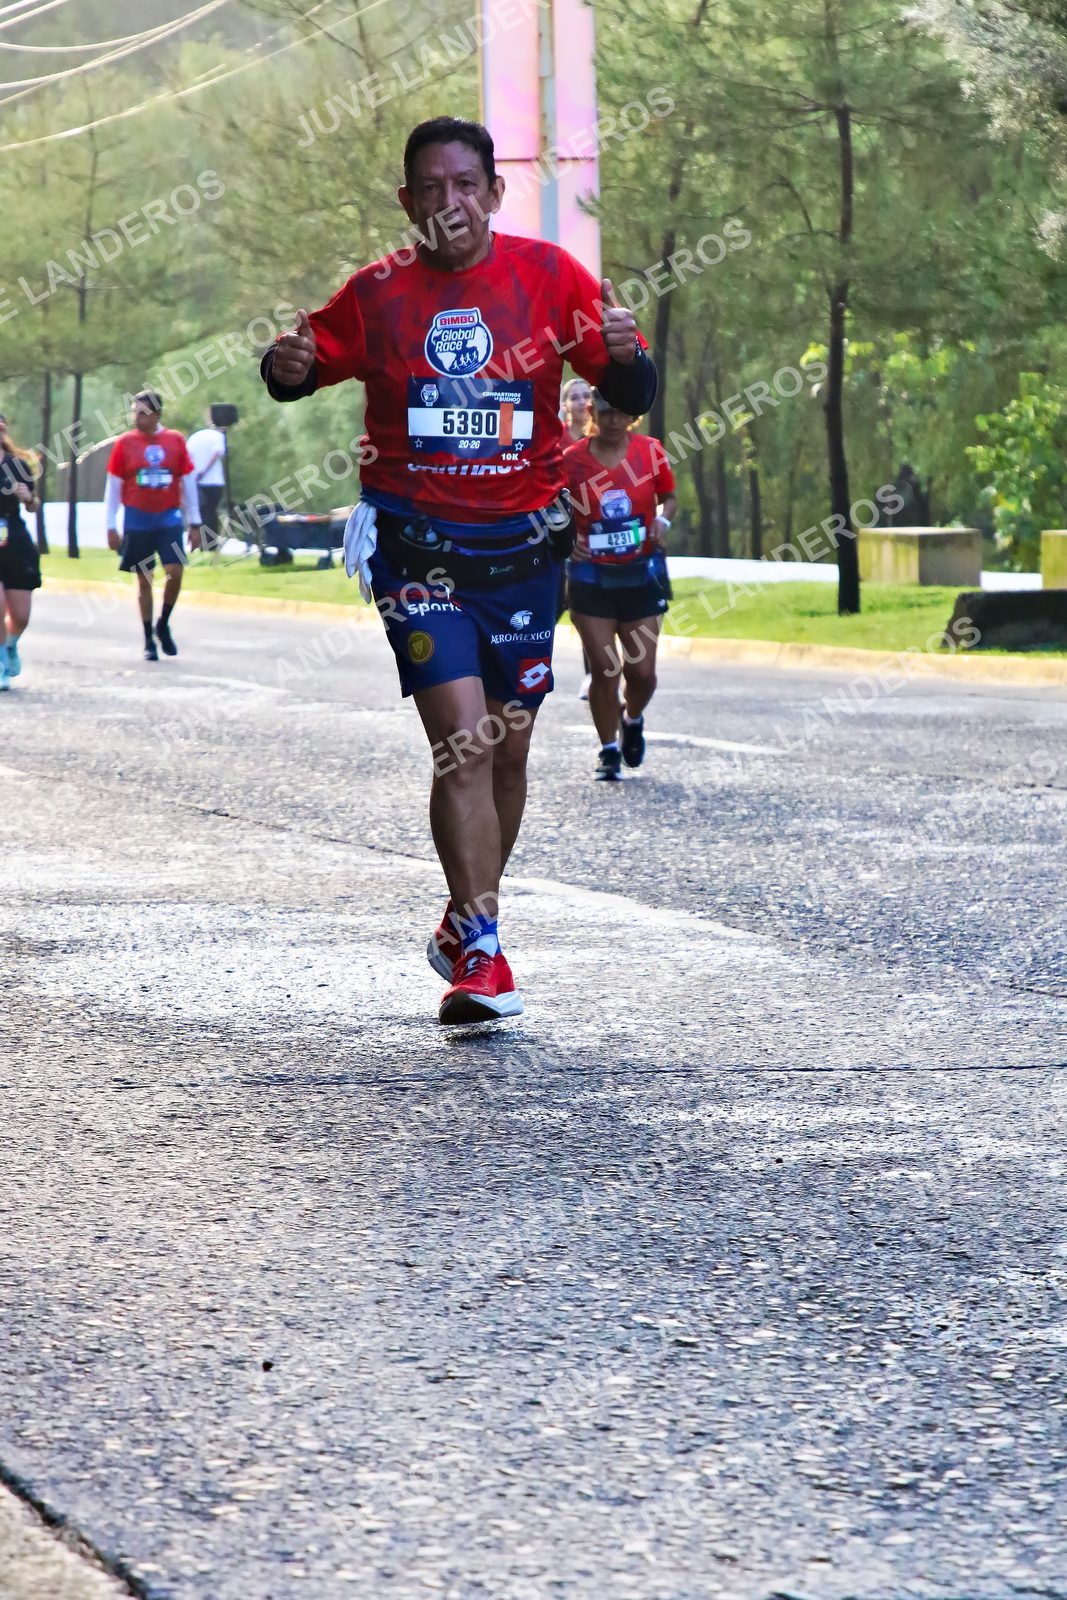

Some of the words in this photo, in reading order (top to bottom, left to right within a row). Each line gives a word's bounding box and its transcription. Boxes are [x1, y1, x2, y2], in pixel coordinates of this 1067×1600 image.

[440, 315, 475, 325] BIMBO
[441, 327, 475, 341] Global
[435, 341, 462, 352] Race
[443, 411, 497, 435] 5390
[501, 453, 519, 461] 10K
[607, 531, 632, 546] 4231
